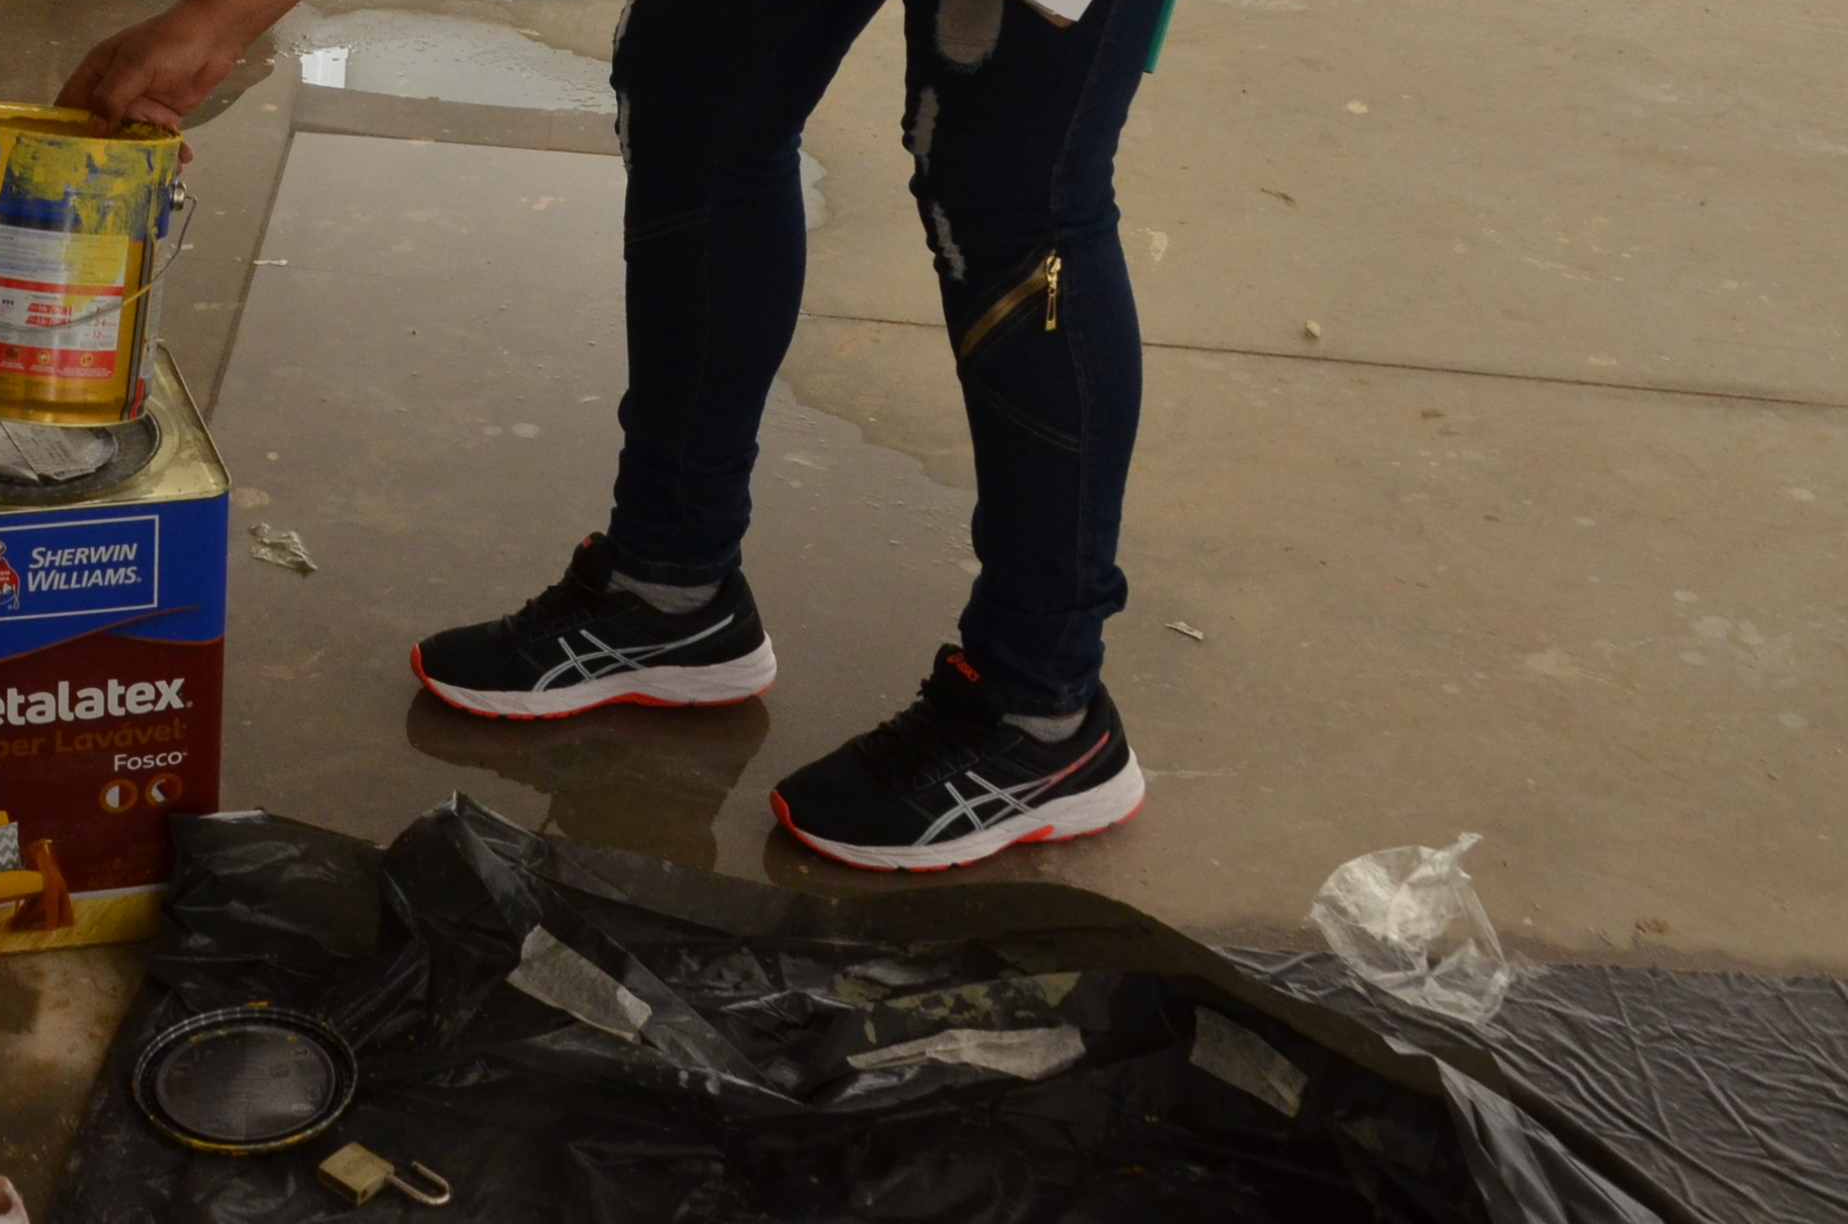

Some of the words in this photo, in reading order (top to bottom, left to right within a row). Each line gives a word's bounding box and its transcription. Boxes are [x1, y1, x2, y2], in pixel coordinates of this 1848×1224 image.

[29, 543, 138, 569] SHERWIN
[27, 566, 137, 592] WILLIAMS
[55, 717, 184, 753] Lavável
[114, 750, 183, 772] Fosco
